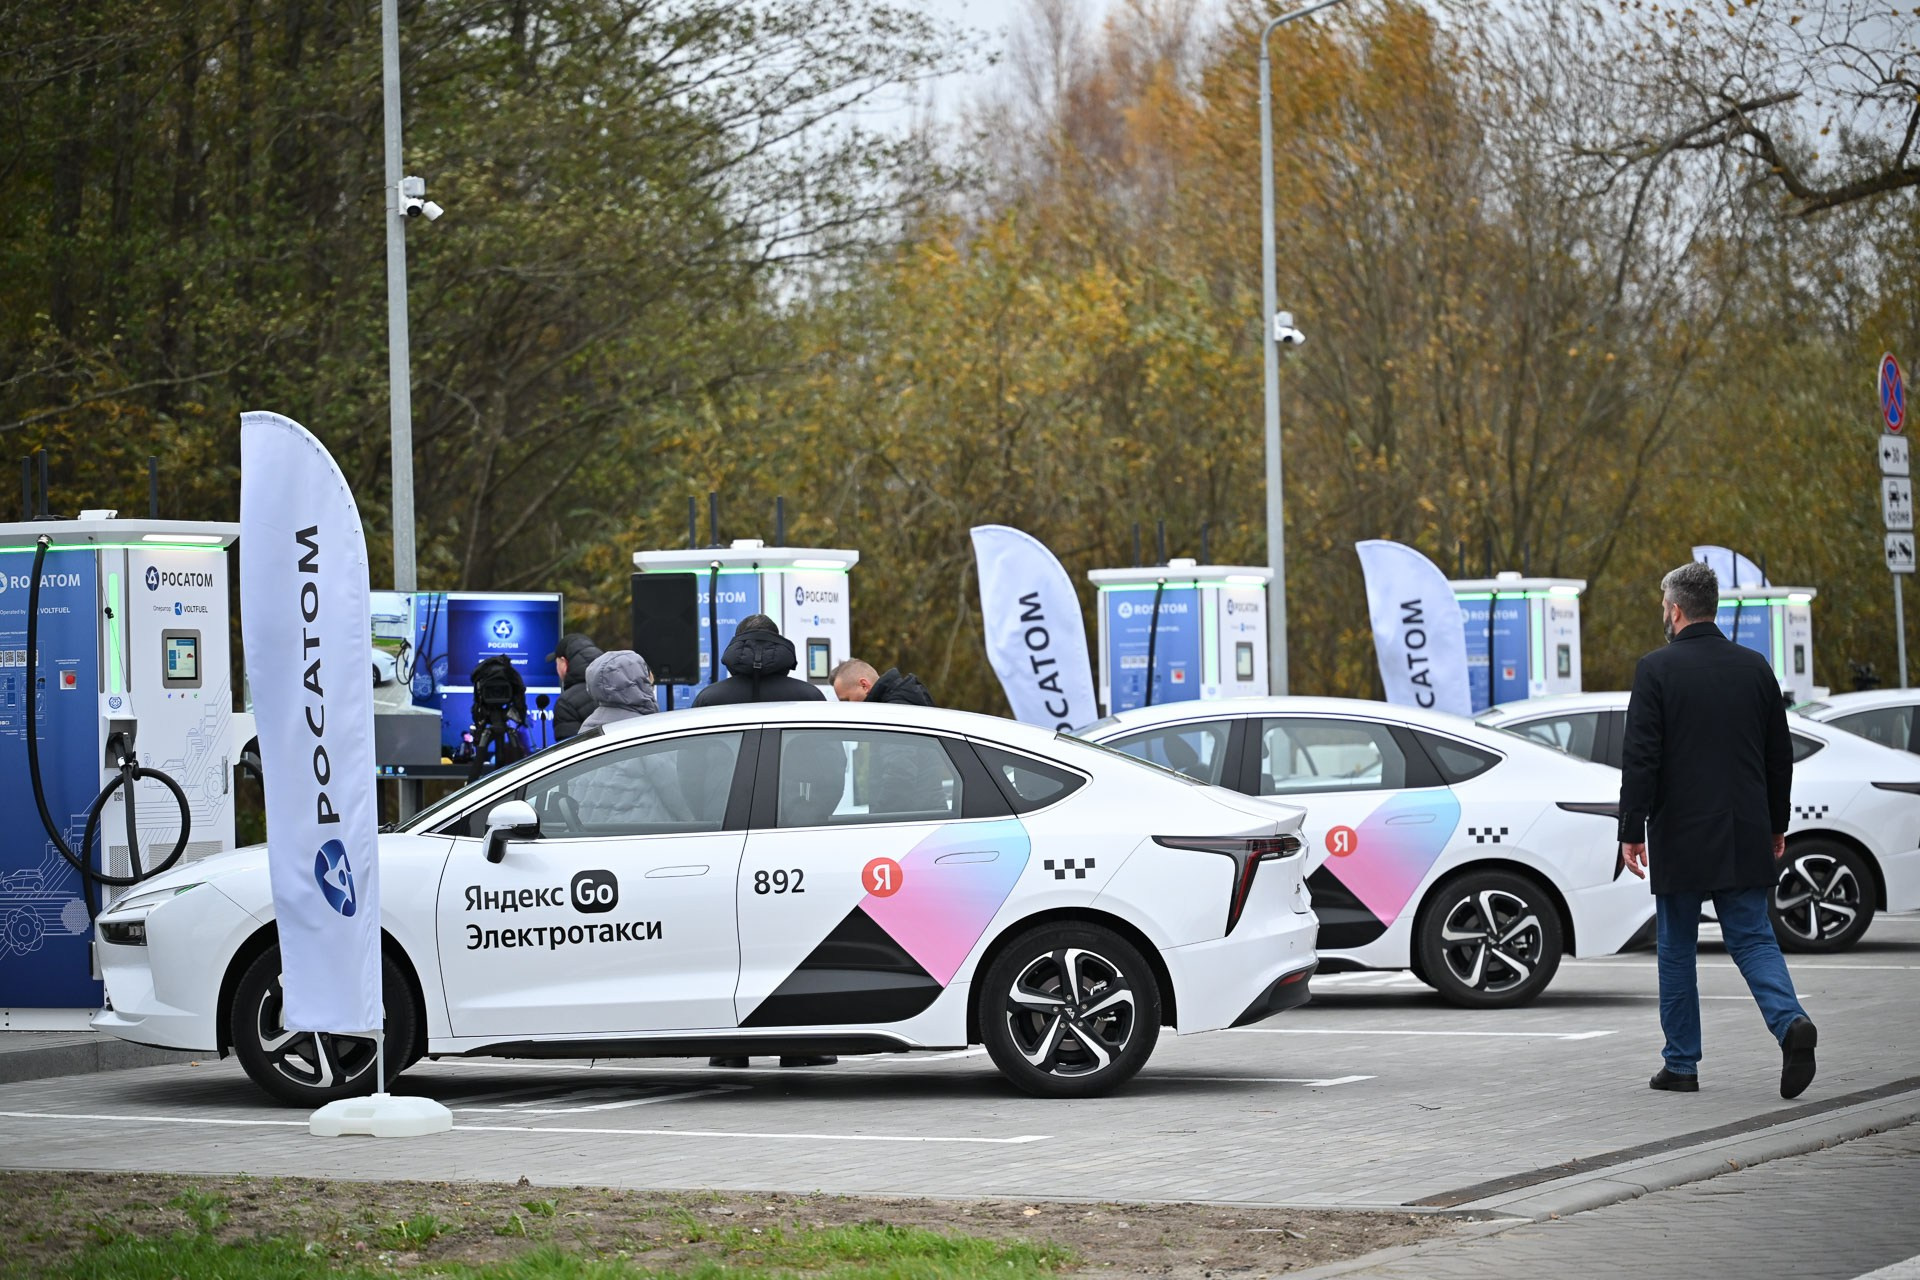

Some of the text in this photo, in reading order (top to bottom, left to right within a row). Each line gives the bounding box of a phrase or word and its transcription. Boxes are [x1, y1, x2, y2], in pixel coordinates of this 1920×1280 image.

[10, 573, 81, 589] ROATOM
[161, 571, 213, 587] РОСАТОМ
[40, 606, 71, 614] VOLTFUEL
[295, 525, 340, 824] РОСАТОМ
[753, 868, 805, 895] 892
[465, 878, 614, 913] Яндекс Go
[466, 920, 663, 951] Электротакси
